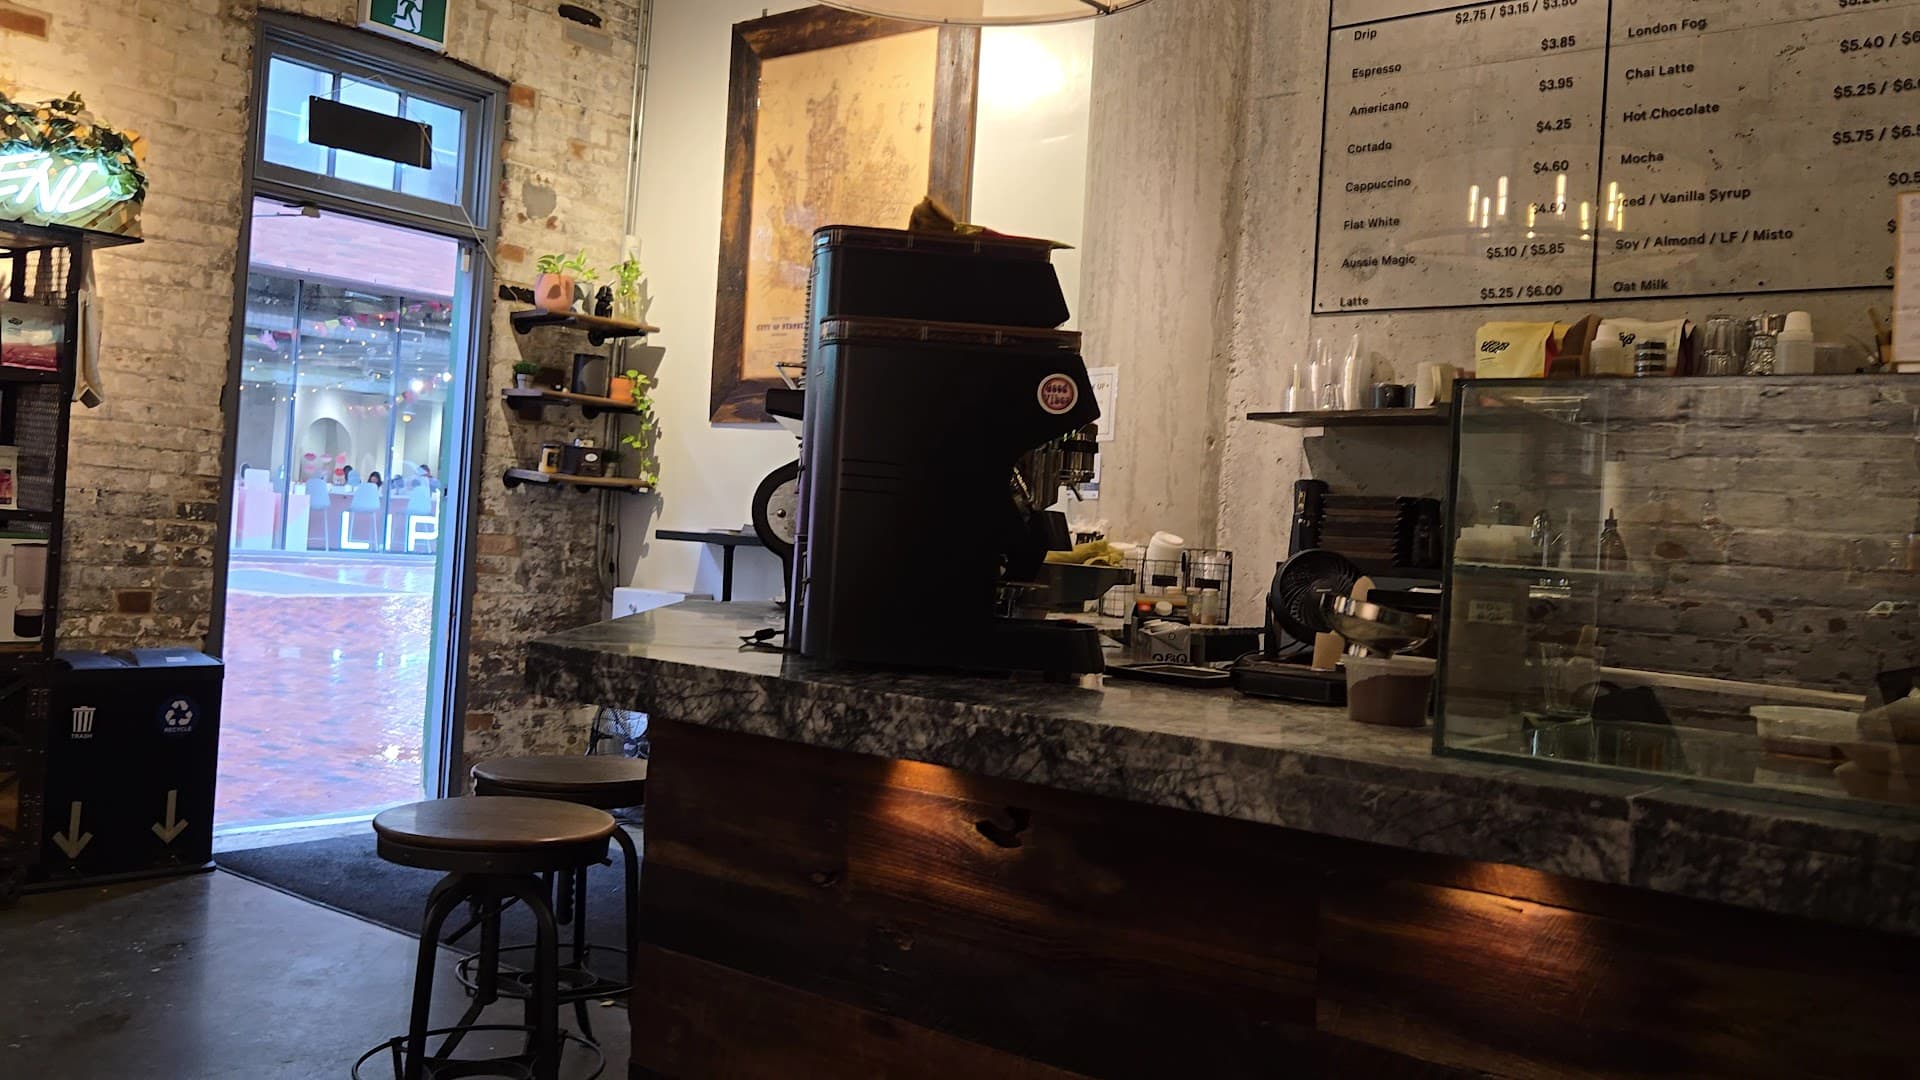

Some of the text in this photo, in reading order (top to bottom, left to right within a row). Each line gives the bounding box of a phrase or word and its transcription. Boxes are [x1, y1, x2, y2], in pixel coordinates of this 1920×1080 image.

[1455, 9, 1487, 25] $2.75
[1499, 2, 1530, 17] $3.15
[1354, 28, 1377, 41] Drip
[1628, 18, 1708, 38] London Fog
[1541, 35, 1576, 51] $3.85
[1840, 37, 1884, 54] $5.40
[1889, 33, 1896, 48] /
[1352, 63, 1401, 79] Espresso
[1625, 62, 1694, 81] Chai Latte
[1539, 77, 1574, 92] $3.95
[1833, 82, 1876, 100] $5.25
[1880, 80, 1887, 95] /
[1350, 100, 1409, 117] Americano
[1623, 103, 1720, 123] Hot Chocolate
[1536, 117, 1572, 133] $4.25
[1832, 129, 1874, 146] $5.75
[1879, 127, 1886, 141] /
[1347, 140, 1392, 154] Cortado
[1620, 150, 1664, 165] Mocha
[1533, 159, 1569, 174] $4.60
[1345, 176, 1412, 193] Cappuccino
[1618, 188, 1751, 207] ced / Vanilla Syrup
[1343, 216, 1400, 231] Flat White
[1615, 238, 1640, 251] Soy
[1653, 234, 1705, 248] Almond
[1721, 231, 1738, 243] LF
[1753, 228, 1793, 242] Misto
[1486, 246, 1517, 260] $5.10
[1530, 243, 1565, 257] $5.85
[1341, 253, 1416, 270] Aussie Magic
[1480, 287, 1514, 301] $5.25
[1526, 284, 1562, 299] $6.00
[1613, 278, 1669, 293] Oat Milk
[1340, 295, 1369, 308] Latte
[71, 732, 93, 740] TRASH
[164, 725, 193, 734] RECYCLE
